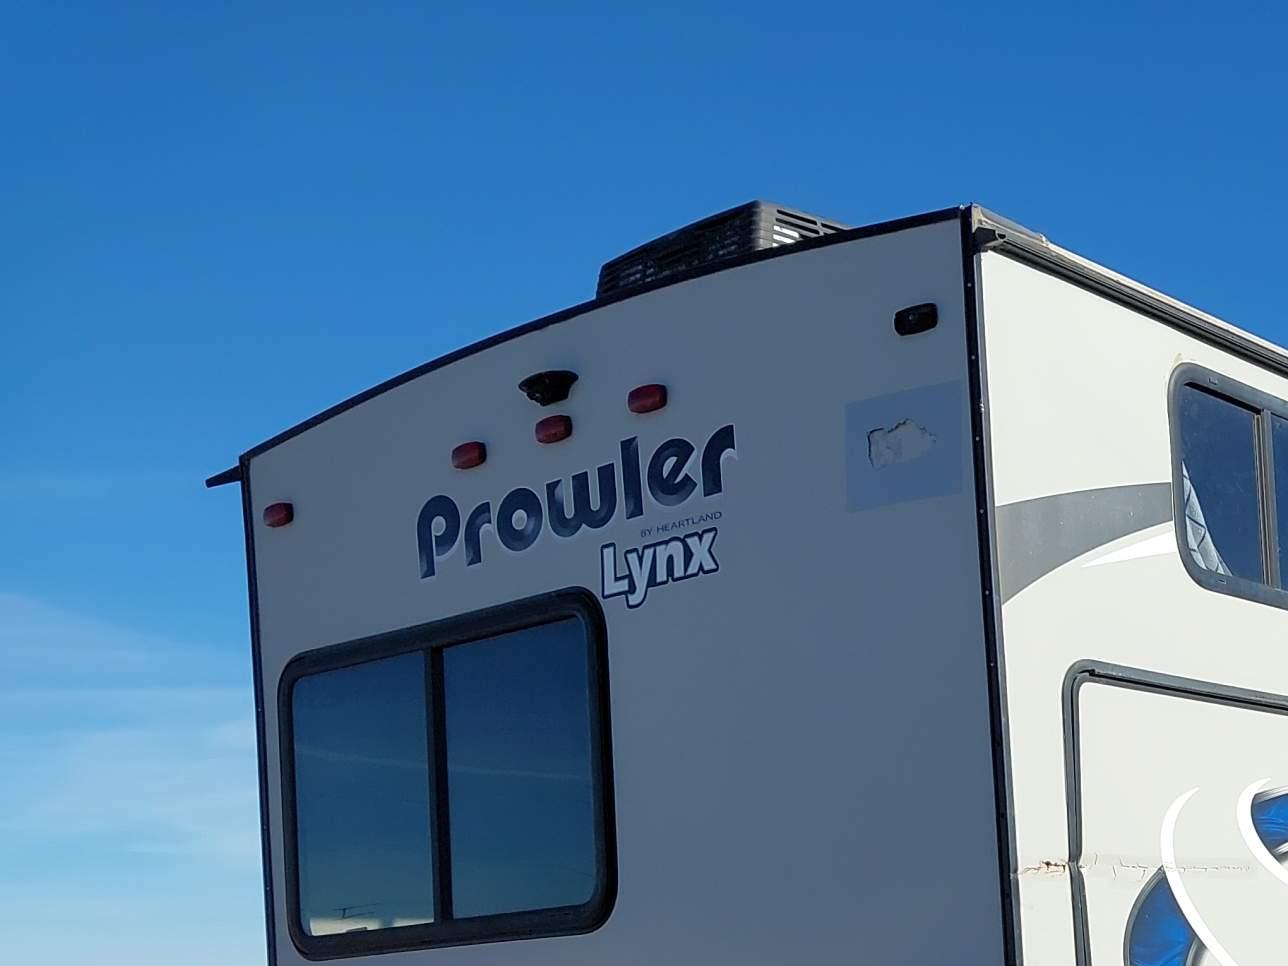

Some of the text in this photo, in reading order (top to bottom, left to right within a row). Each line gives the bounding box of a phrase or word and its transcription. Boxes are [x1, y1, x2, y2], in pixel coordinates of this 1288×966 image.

[416, 423, 738, 579] Prowler
[640, 511, 722, 538] BY HEARTLAND
[601, 527, 719, 609] Lynx
